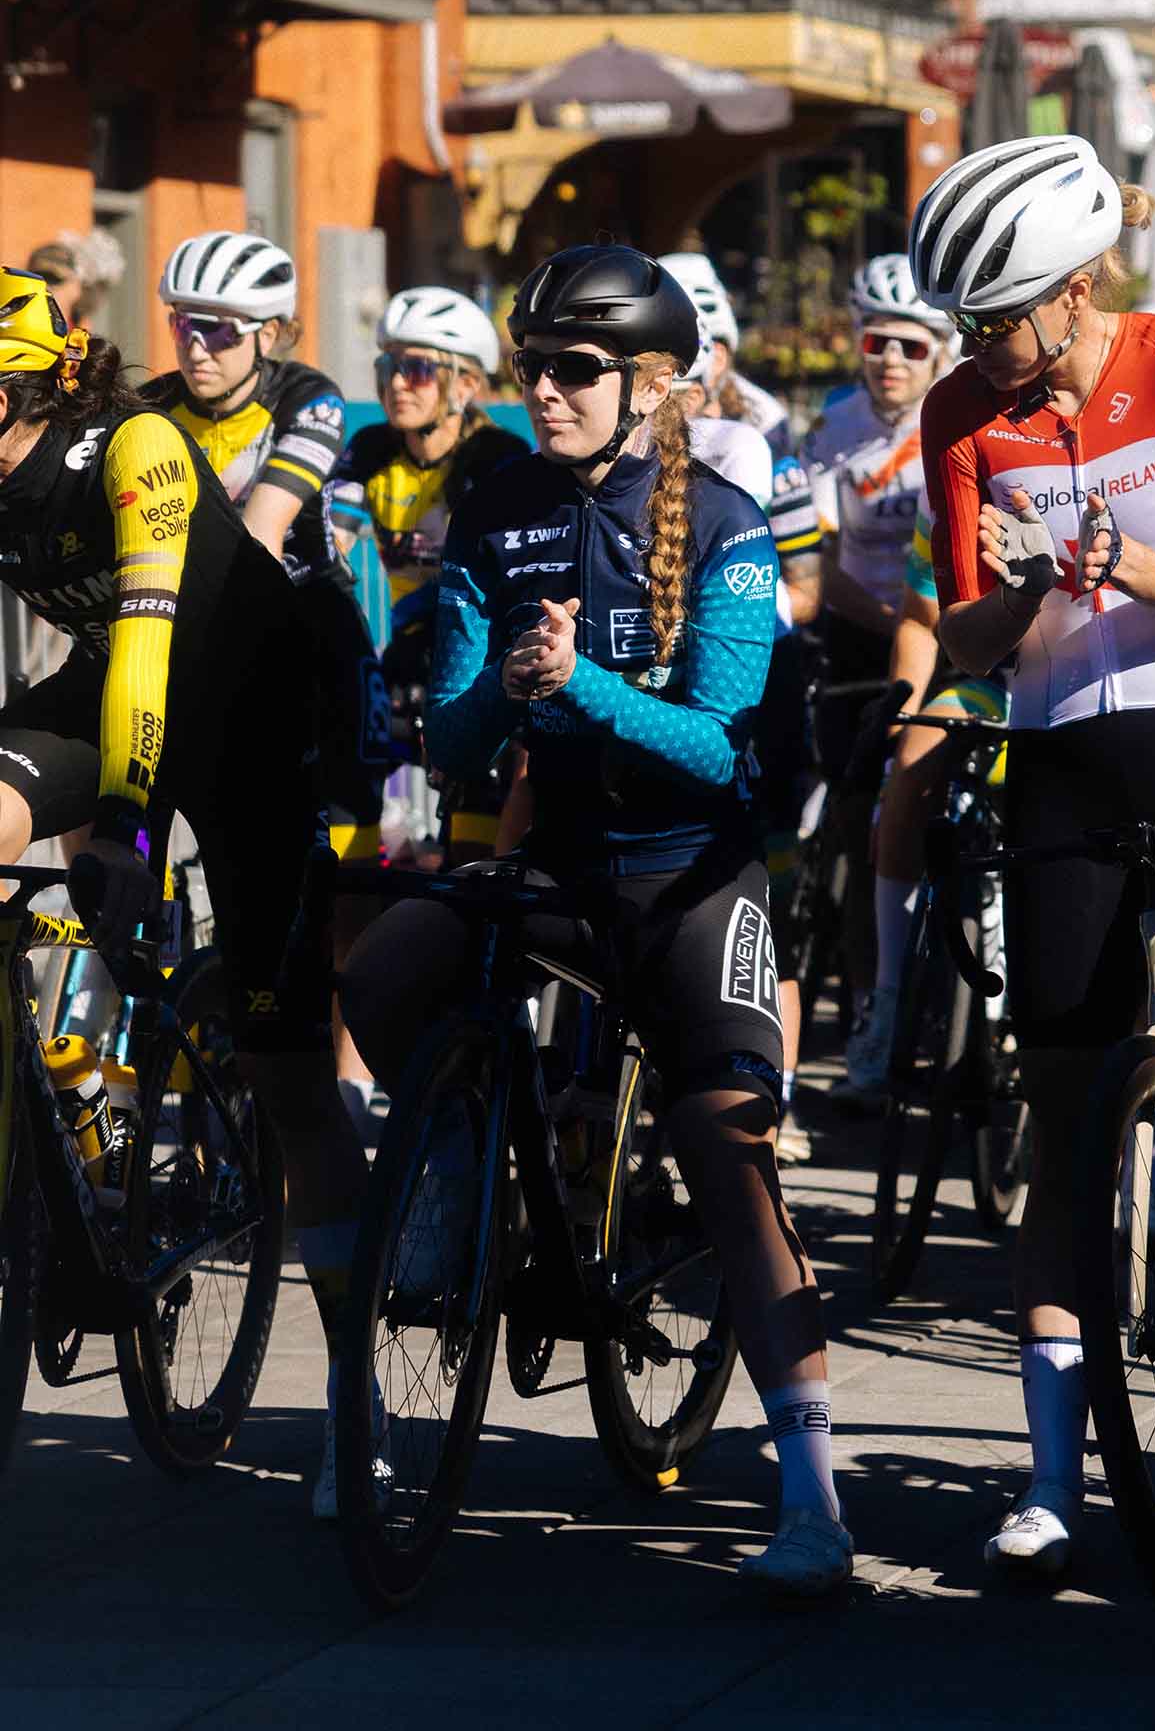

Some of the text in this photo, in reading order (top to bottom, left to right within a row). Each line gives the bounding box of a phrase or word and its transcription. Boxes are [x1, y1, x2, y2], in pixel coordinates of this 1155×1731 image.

[137, 459, 188, 492] VISMA
[140, 497, 186, 525] lease
[527, 524, 571, 545] ZWIFT
[722, 525, 769, 552] SRAM
[141, 711, 155, 762] FOOD
[733, 906, 759, 996] TWENTY
